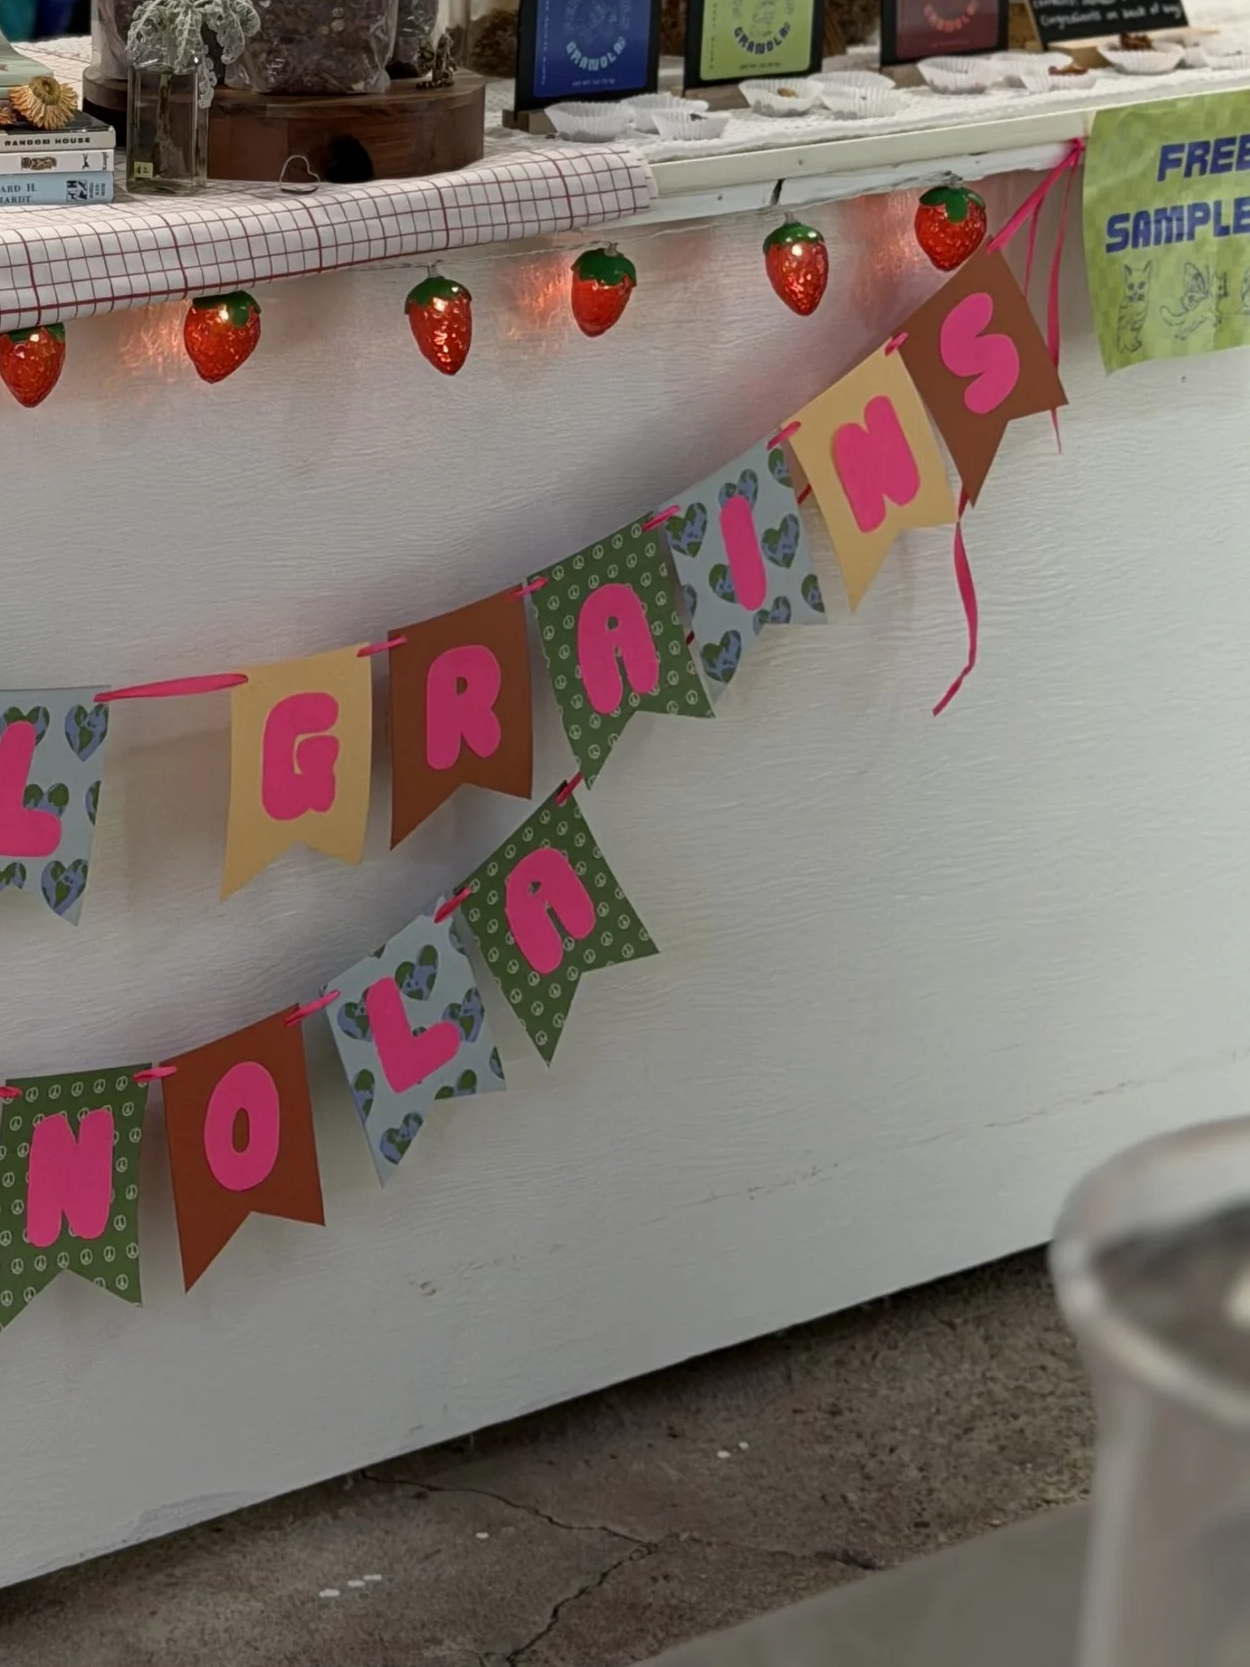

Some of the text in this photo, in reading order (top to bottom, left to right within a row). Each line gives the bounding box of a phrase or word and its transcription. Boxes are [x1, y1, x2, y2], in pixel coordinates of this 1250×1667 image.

[566, 36, 626, 71] GRANOLA
[734, 22, 791, 54] GRANOLA
[4, 138, 51, 147] RANDOM
[54, 136, 91, 145] HOUSE
[1157, 133, 1250, 183] FREE
[261, 290, 1021, 822] GRAINS
